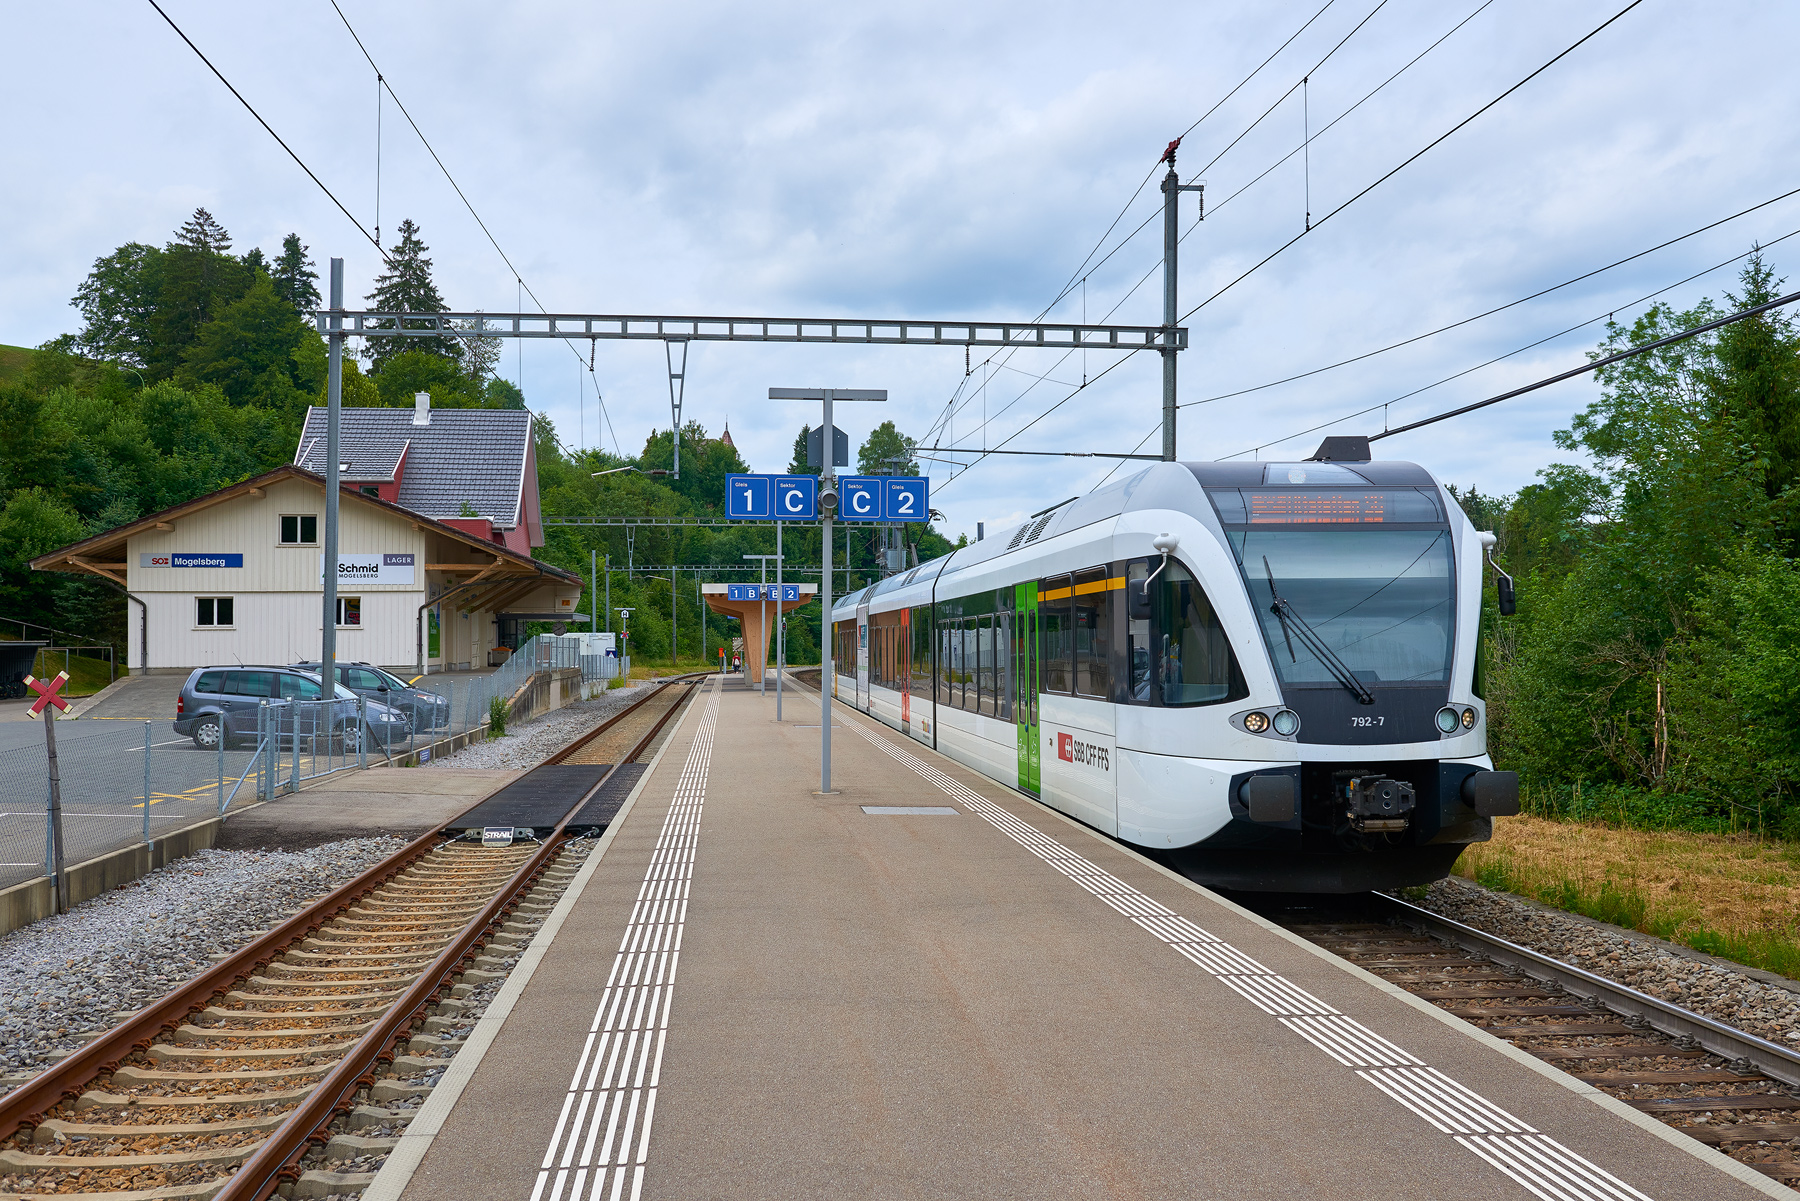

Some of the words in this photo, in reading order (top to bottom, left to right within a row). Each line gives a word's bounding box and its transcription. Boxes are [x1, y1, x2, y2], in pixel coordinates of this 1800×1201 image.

[744, 489, 752, 511] 1
[785, 490, 803, 512] C
[852, 491, 871, 513] C
[898, 492, 914, 514] 2
[174, 557, 226, 567] Mogelsberg
[338, 563, 379, 573] Schmid
[733, 589, 738, 598] 1
[748, 589, 756, 598] B
[787, 590, 795, 599] 2
[1351, 716, 1385, 727] 792-7
[1073, 739, 1085, 763] SBB
[1085, 742, 1097, 767] CFF
[1097, 746, 1110, 772] FFS
[484, 831, 512, 839] STRAIL
